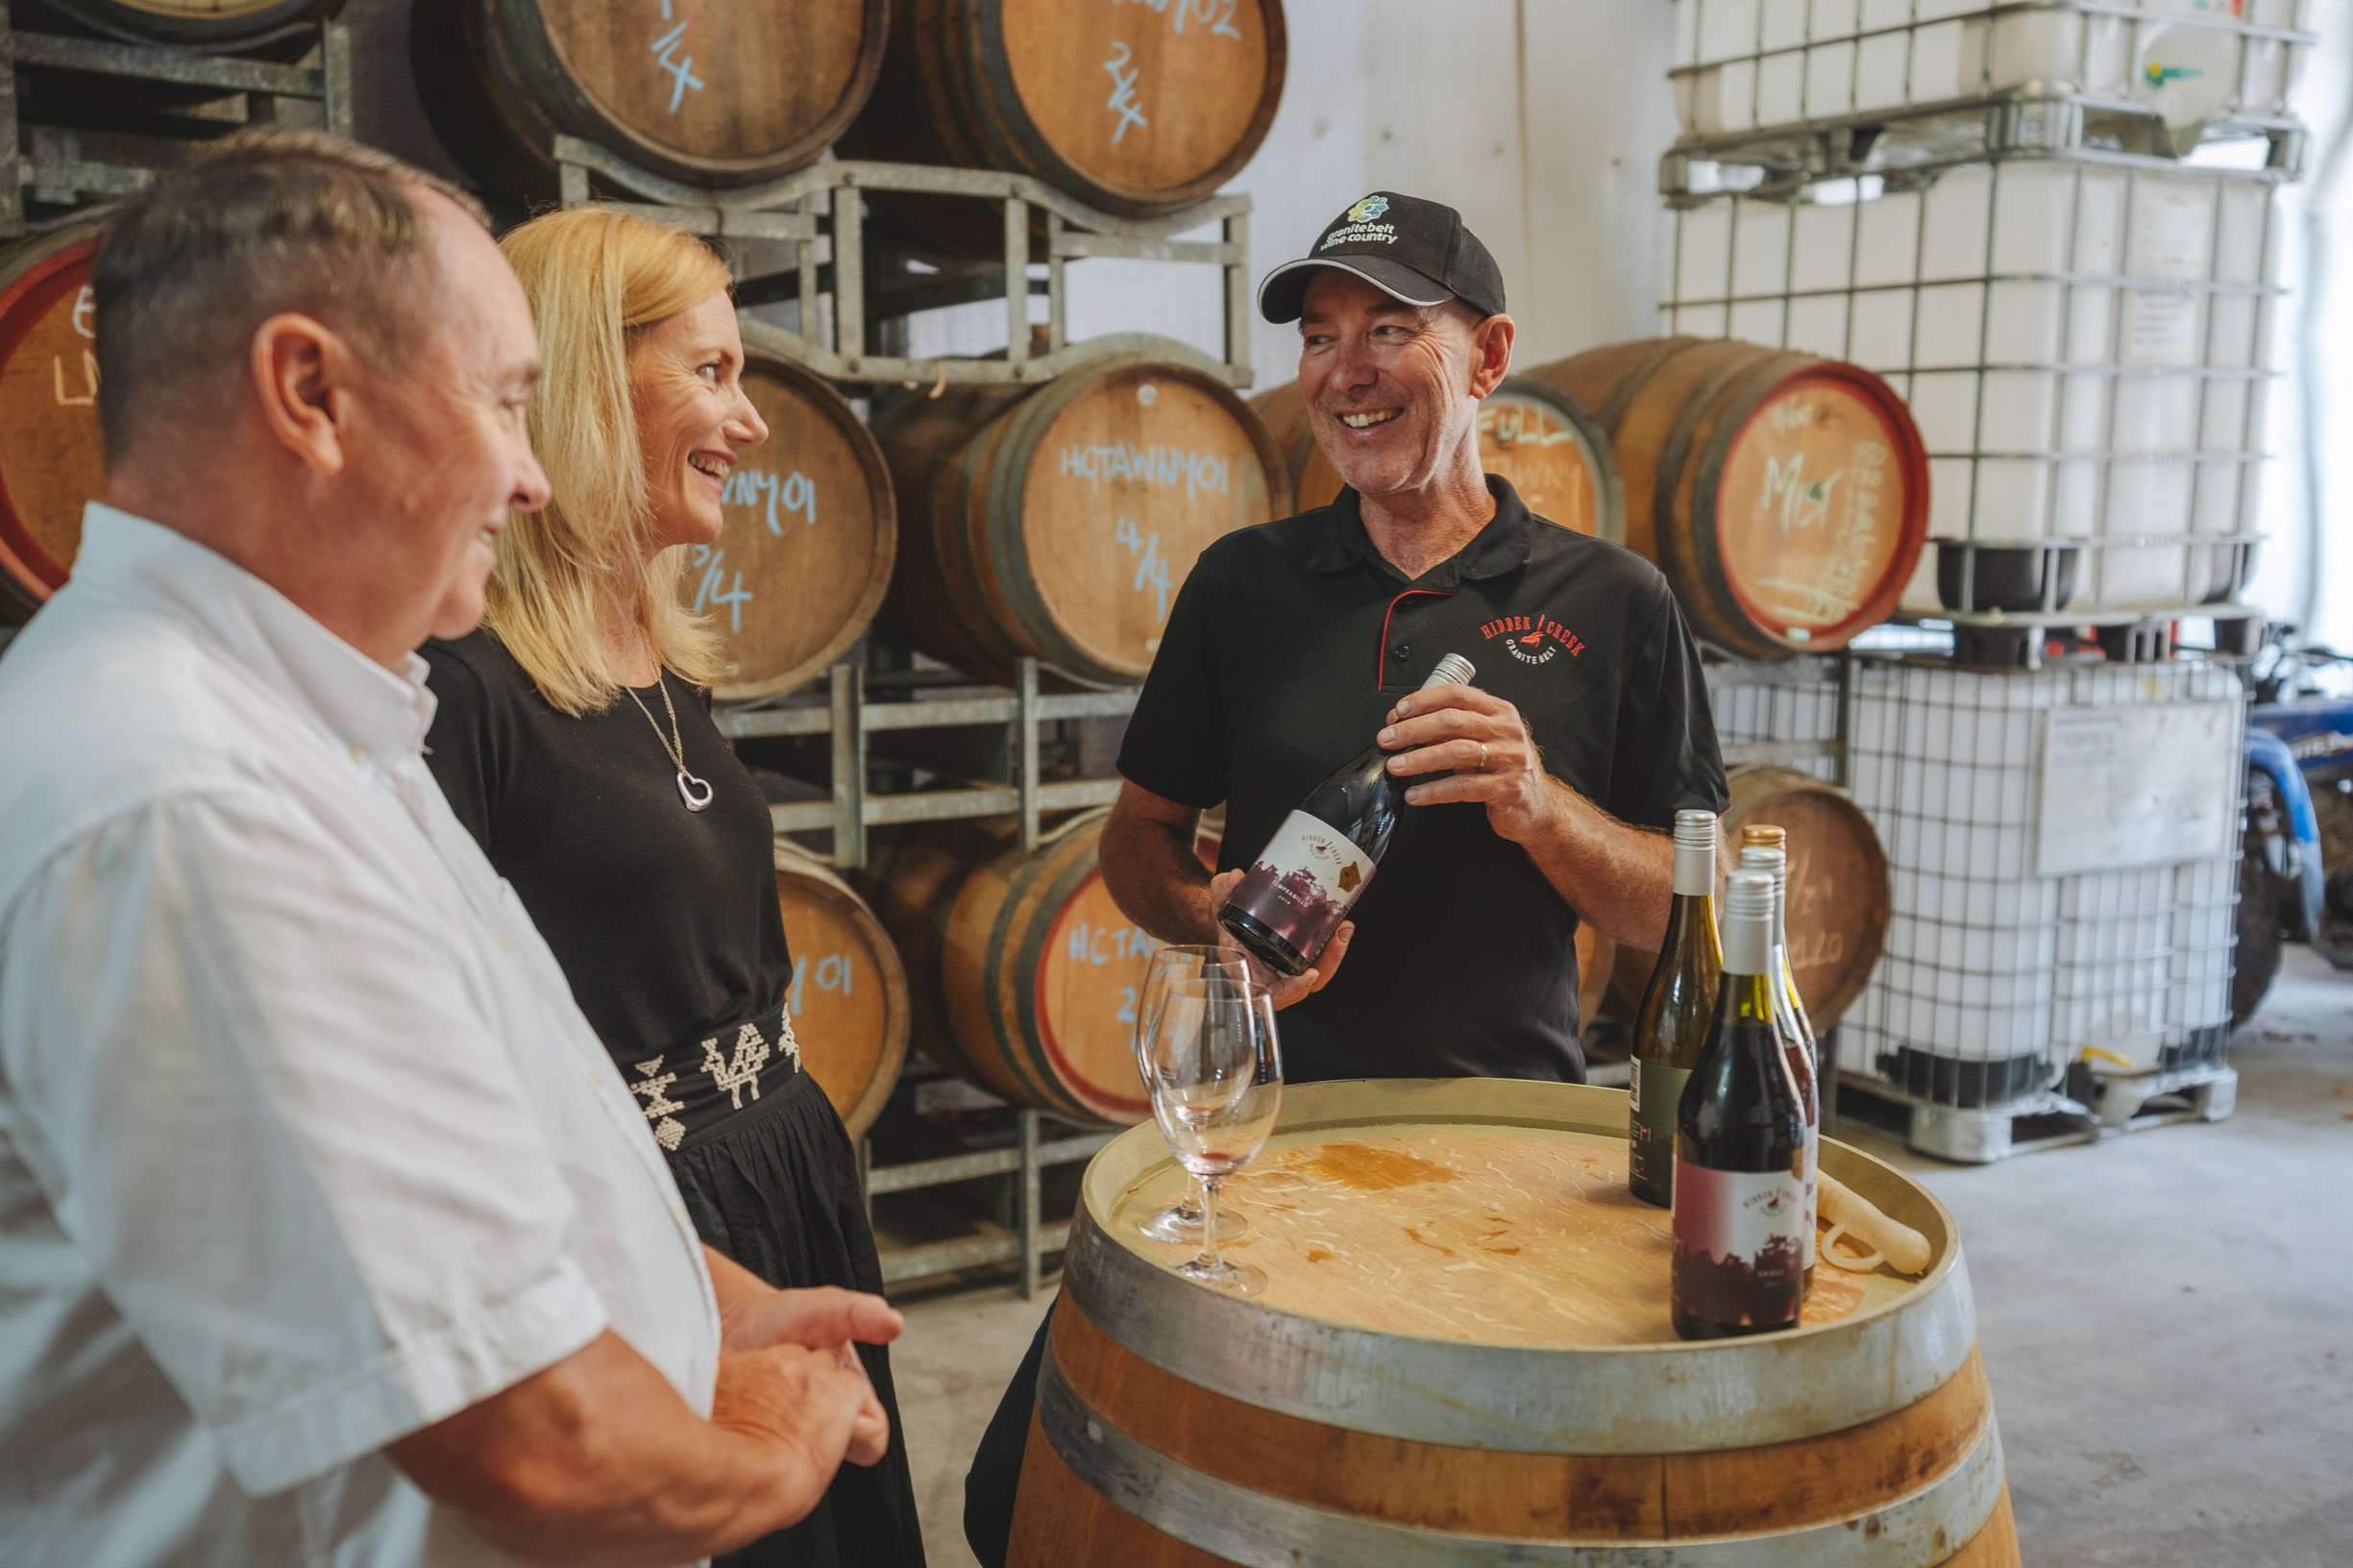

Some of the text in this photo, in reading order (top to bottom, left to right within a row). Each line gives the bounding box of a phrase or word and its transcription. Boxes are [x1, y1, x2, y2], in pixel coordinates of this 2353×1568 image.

[1347, 232, 1398, 245] country
[1480, 616, 1585, 657] HIDDEN CREEK
[1506, 639, 1556, 665] GRANITE BELT
[1272, 880, 1309, 908] TEMPRANILLO
